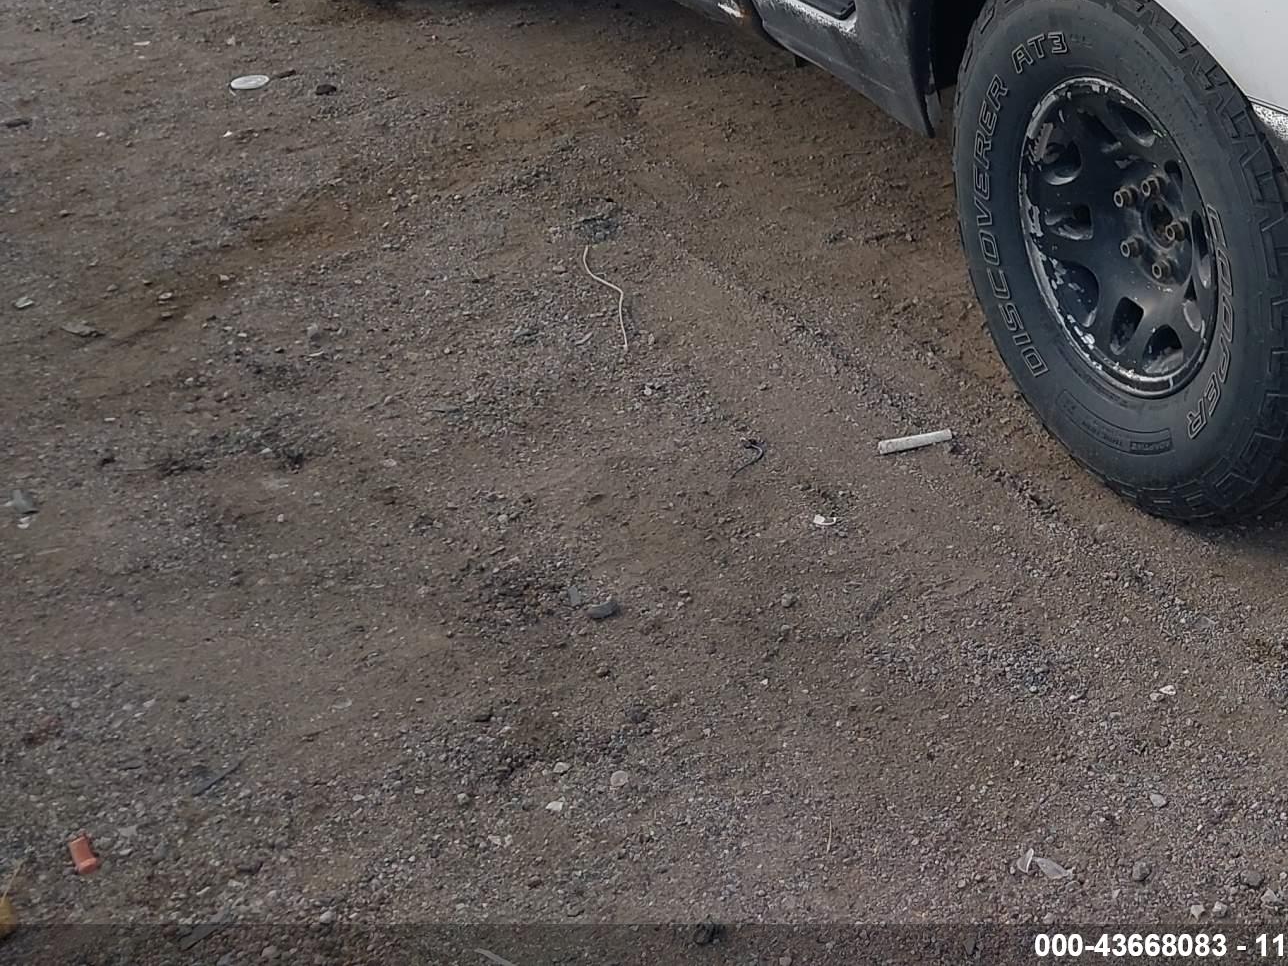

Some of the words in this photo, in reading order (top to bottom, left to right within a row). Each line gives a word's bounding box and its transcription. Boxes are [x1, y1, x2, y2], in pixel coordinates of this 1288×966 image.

[973, 74, 1049, 378] DISCOVERER
[1011, 31, 1068, 74] AT3
[1187, 203, 1234, 440] COOPER
